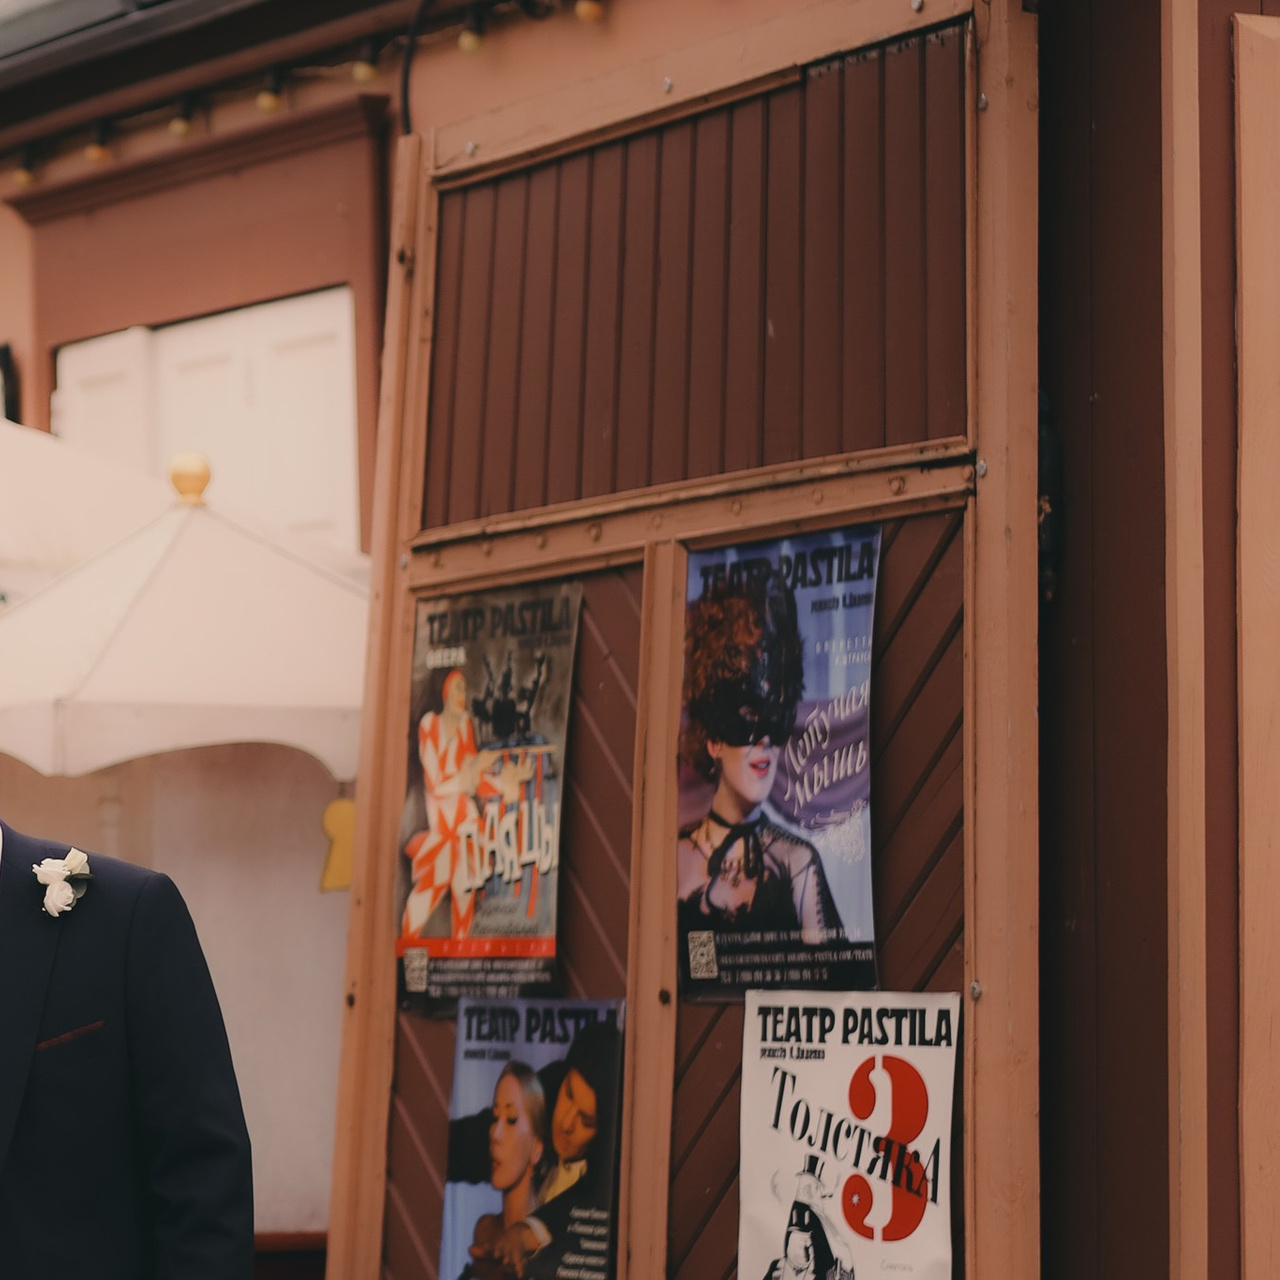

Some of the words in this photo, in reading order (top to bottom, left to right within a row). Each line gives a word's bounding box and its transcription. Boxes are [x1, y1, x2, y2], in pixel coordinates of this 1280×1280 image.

[464, 1006, 519, 1042] ТЕАТР
[757, 1006, 835, 1044] ТЕАТР
[841, 1008, 953, 1047] PASTILA
[841, 1054, 929, 1242] 3
